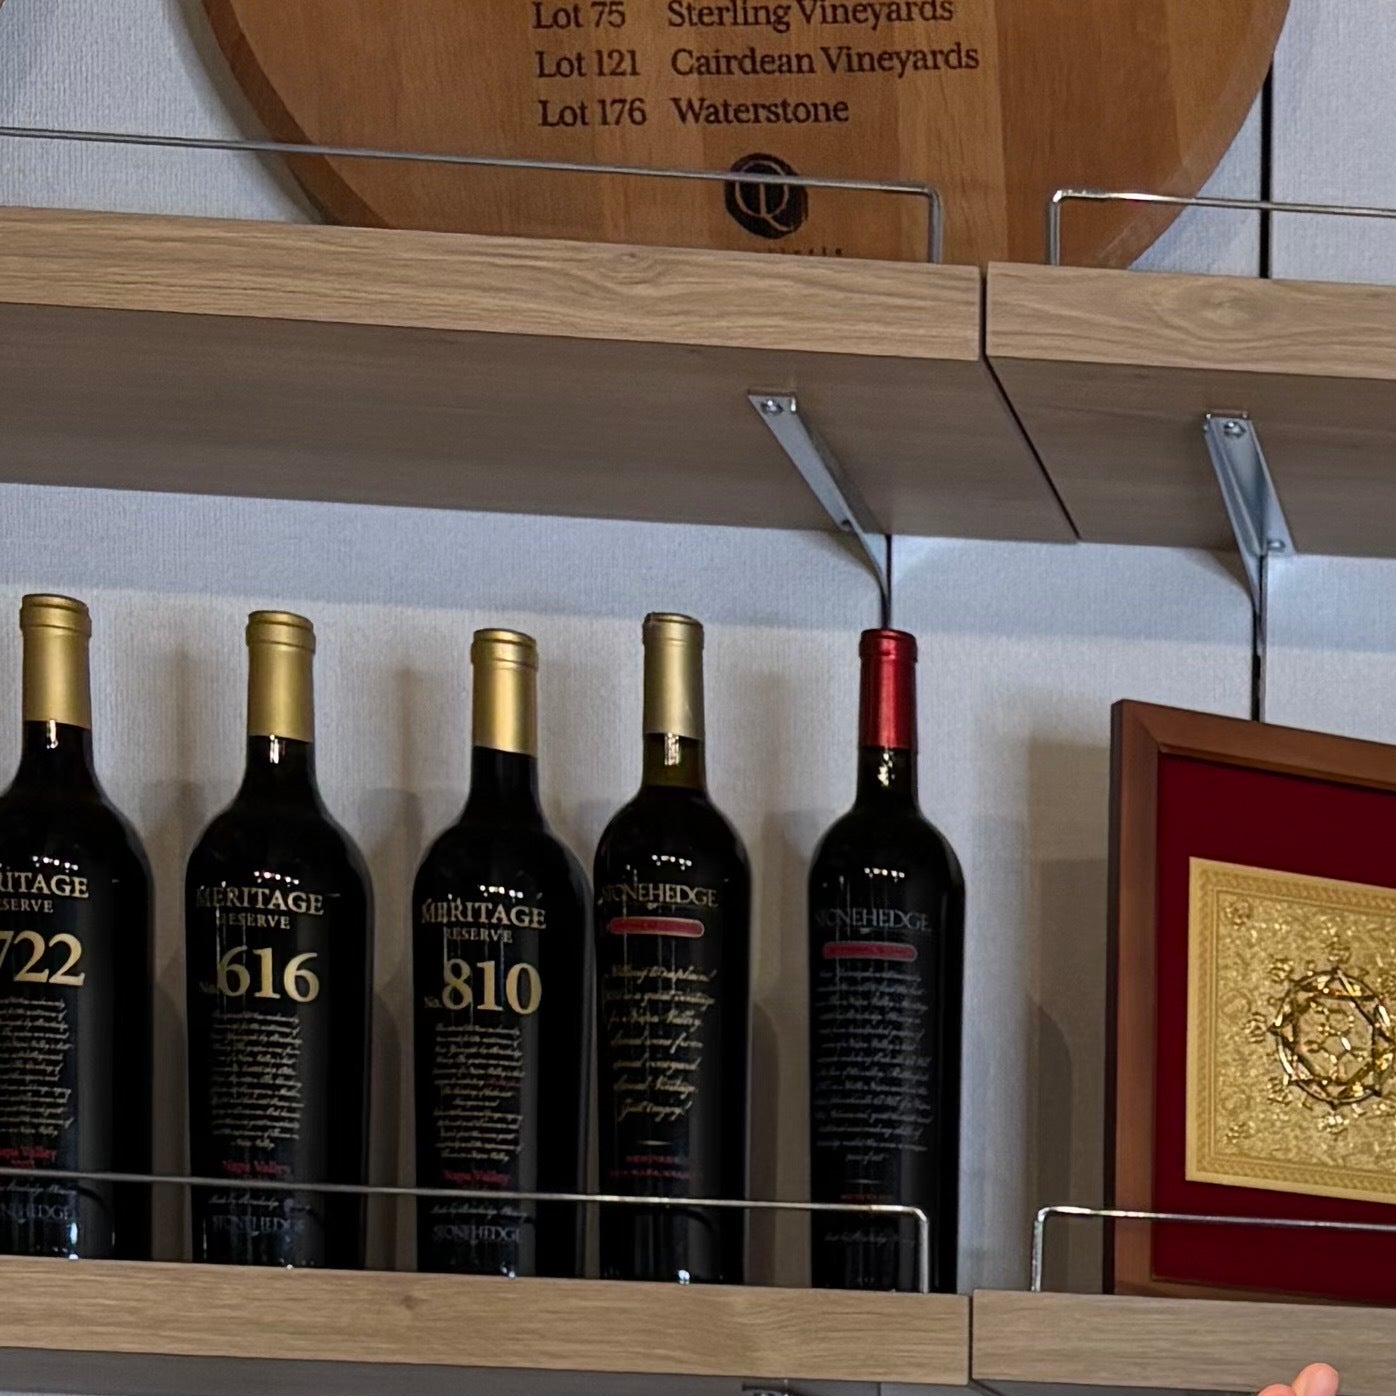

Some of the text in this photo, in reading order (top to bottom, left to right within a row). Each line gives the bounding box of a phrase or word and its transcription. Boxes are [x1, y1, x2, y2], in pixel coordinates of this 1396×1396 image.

[533, 0, 955, 32] Lot 75 Sterling Vineyards
[536, 42, 980, 79] Lot 121 Cairdean Vineyards
[538, 97, 850, 127] Lot 176 Waterstone
[0, 872, 89, 898] ITAGE
[196, 886, 324, 915] MERITAGE
[421, 900, 546, 929] MERITAGE
[220, 912, 290, 929] RESERVE
[446, 927, 512, 943] RESERVE
[0, 930, 85, 986] 722
[217, 945, 319, 1002] 616
[442, 958, 542, 1015] 810
